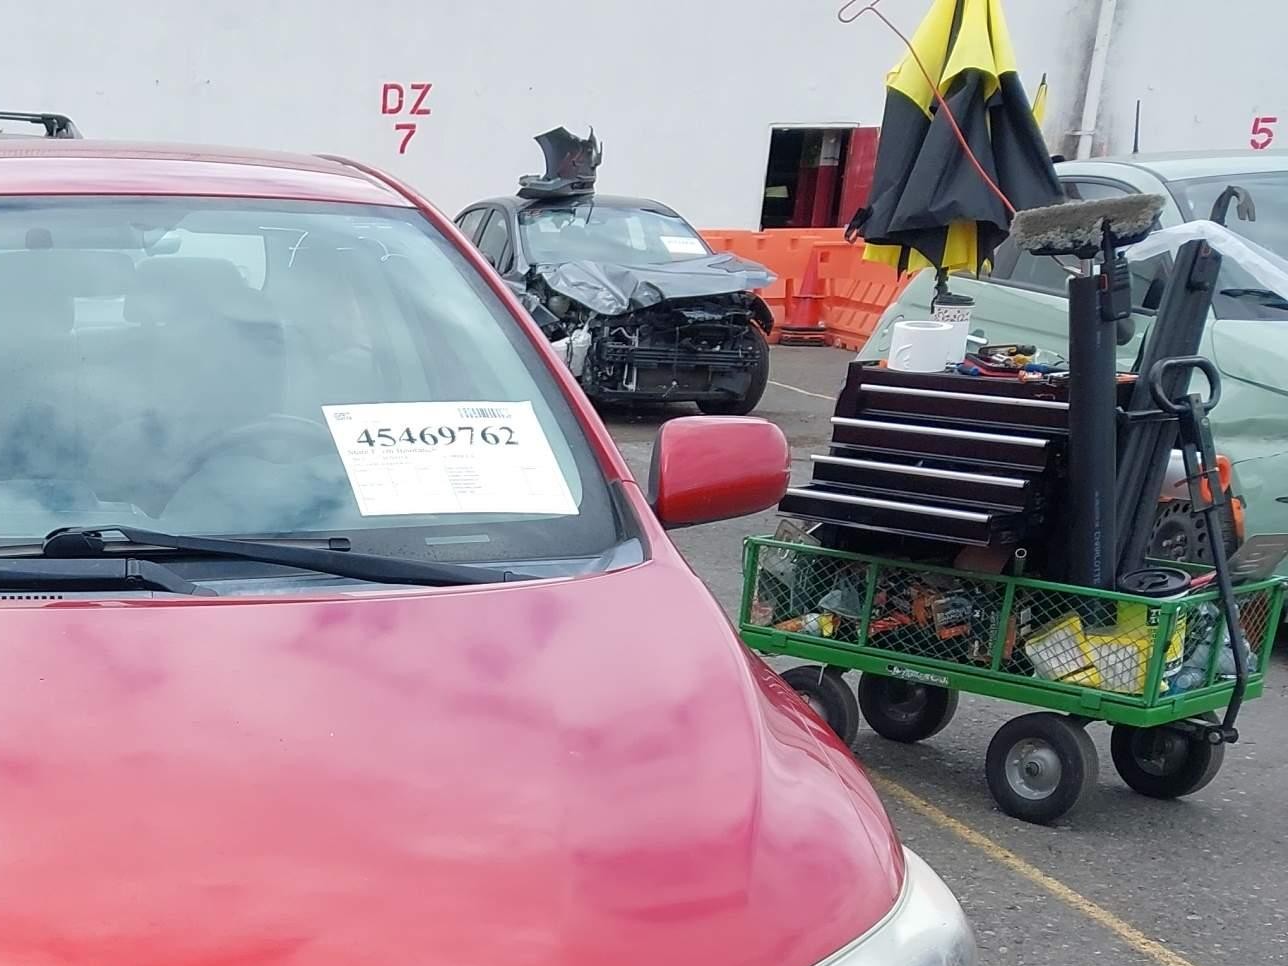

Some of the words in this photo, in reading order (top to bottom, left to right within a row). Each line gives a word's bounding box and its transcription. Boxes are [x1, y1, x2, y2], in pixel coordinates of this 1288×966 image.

[381, 83, 432, 116] DZ
[395, 123, 418, 154] 7
[1250, 116, 1278, 150] 5
[355, 425, 520, 448] 45469762
